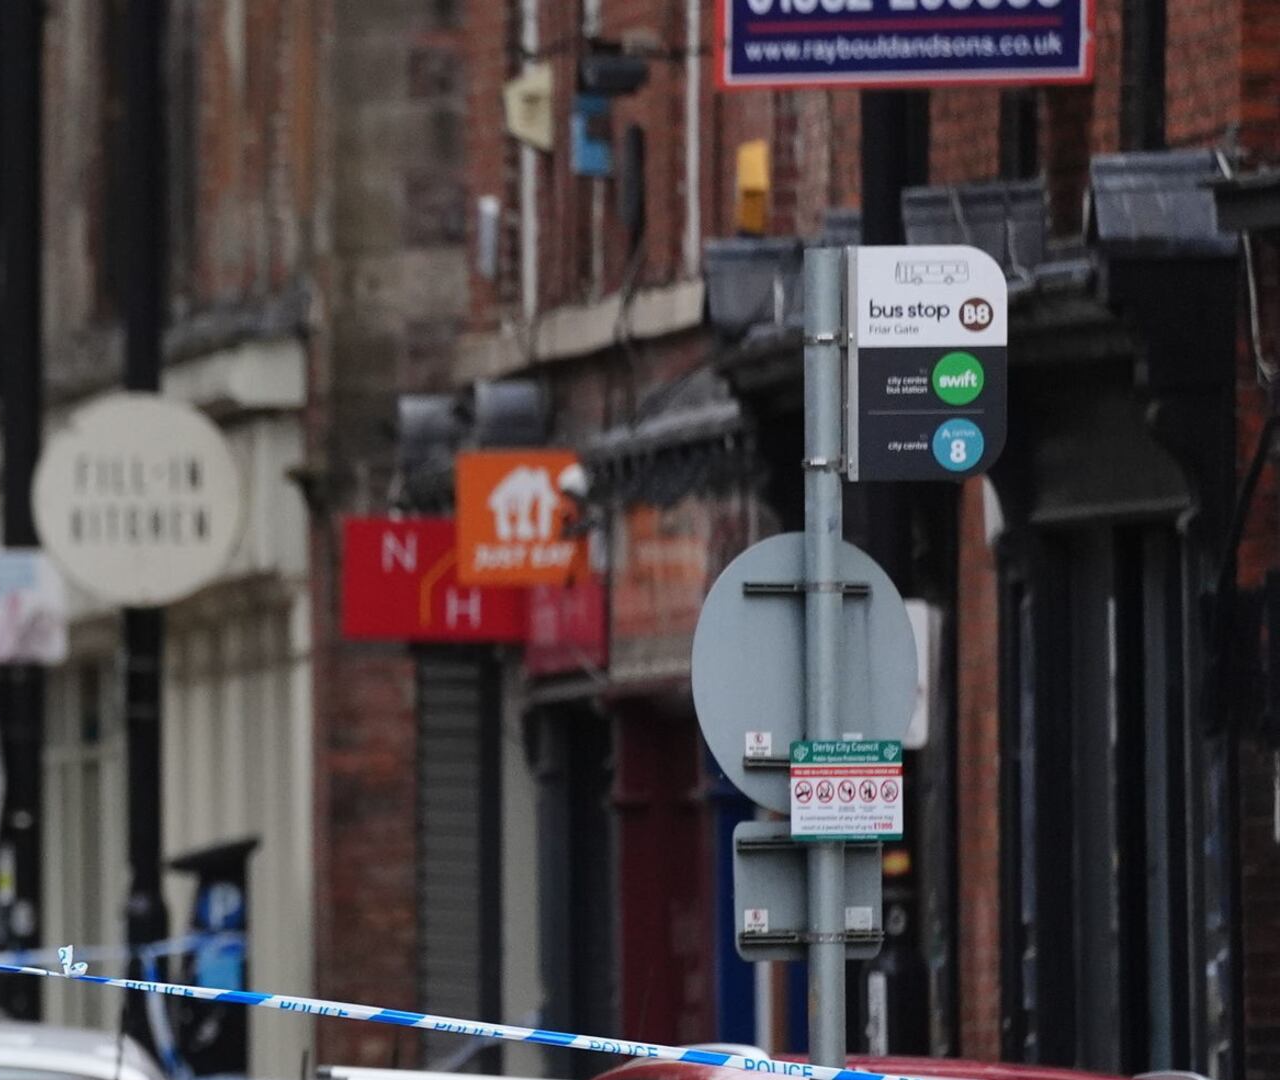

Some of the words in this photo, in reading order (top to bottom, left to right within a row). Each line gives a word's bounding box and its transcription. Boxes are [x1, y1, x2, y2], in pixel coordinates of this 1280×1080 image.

[870, 300, 903, 318] bus
[908, 302, 950, 322] stop
[964, 304, 990, 325] B8
[869, 325, 890, 335] Friar
[894, 325, 919, 334] Gate
[939, 369, 978, 389] swift
[949, 438, 967, 464] 8
[381, 531, 417, 573] N
[445, 588, 482, 629] H
